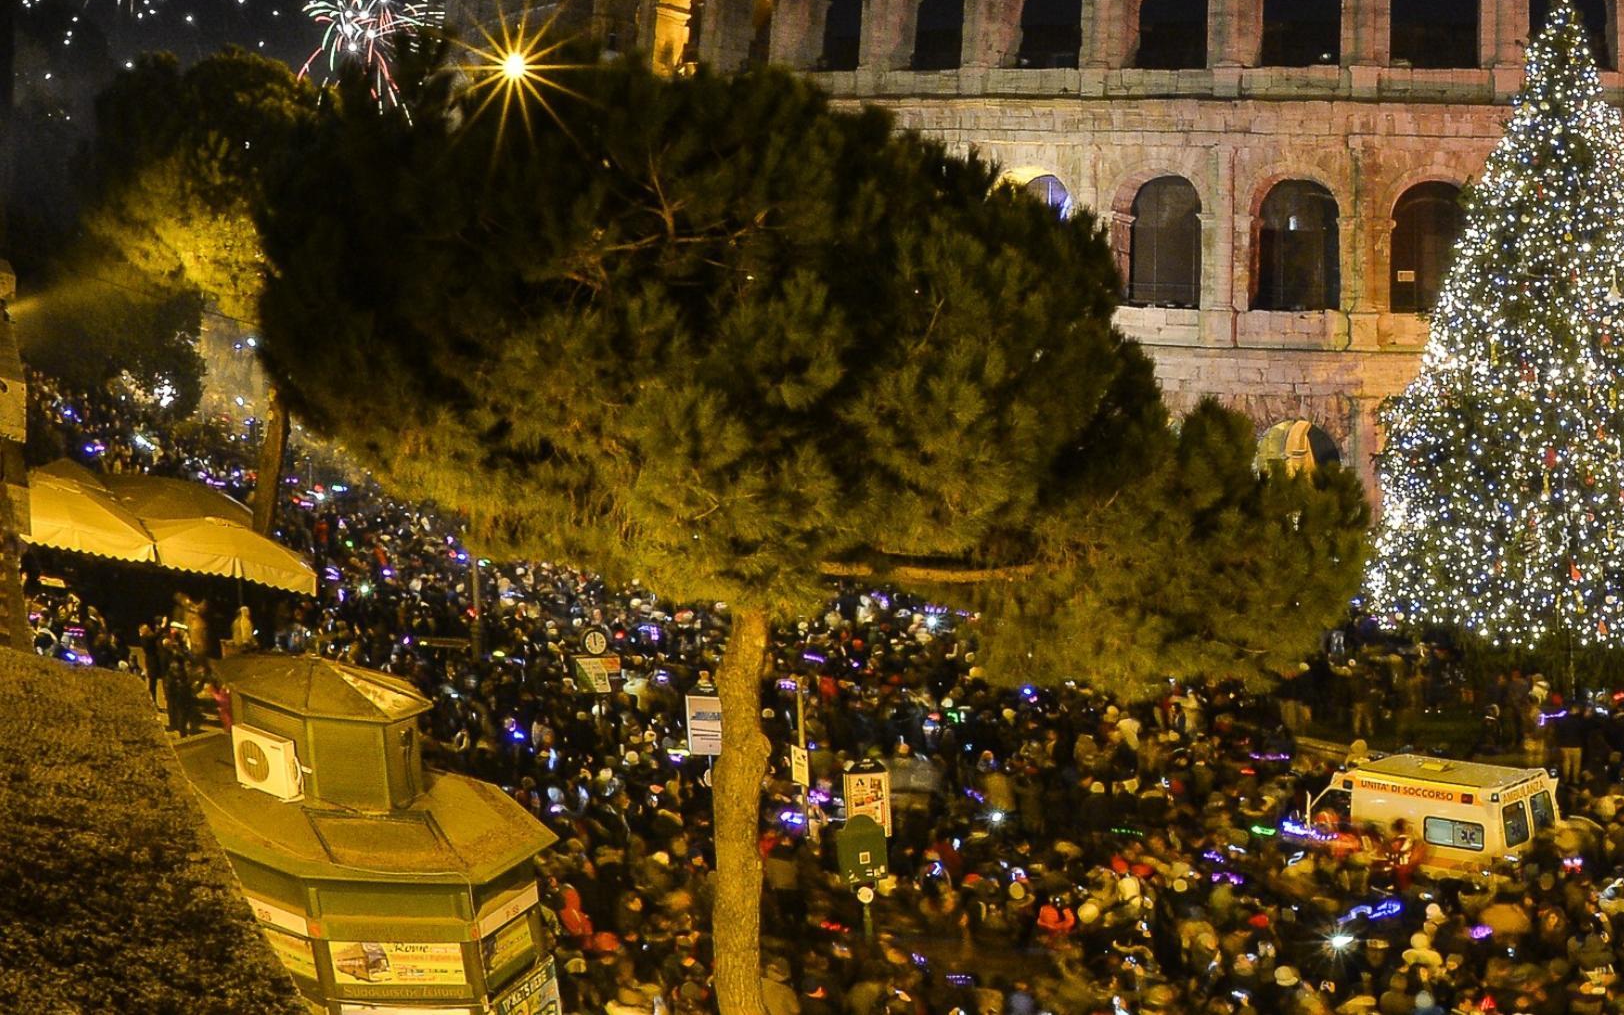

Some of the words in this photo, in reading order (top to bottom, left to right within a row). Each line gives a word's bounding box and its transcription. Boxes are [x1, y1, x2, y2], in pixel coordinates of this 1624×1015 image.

[1391, 784, 1400, 793] DI
[1402, 786, 1454, 801] SOCCORSO
[1503, 780, 1544, 804] AMBULANZA
